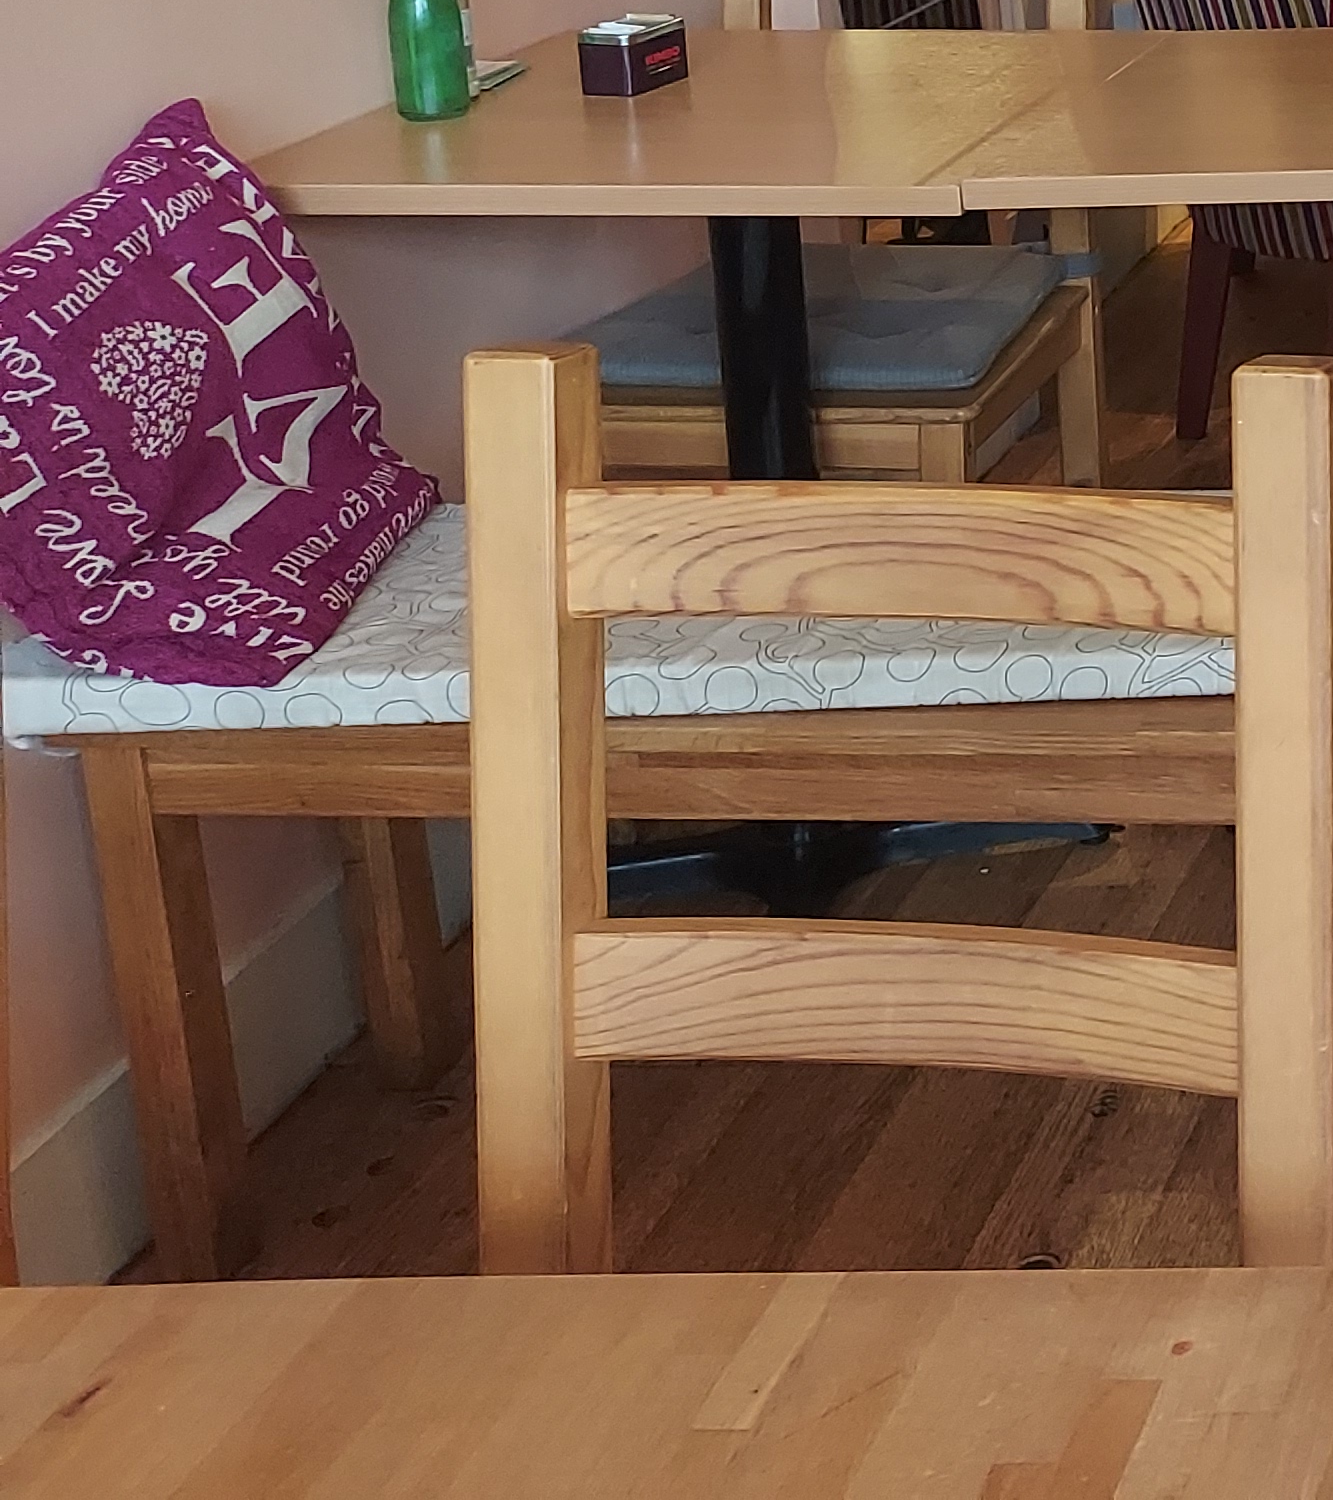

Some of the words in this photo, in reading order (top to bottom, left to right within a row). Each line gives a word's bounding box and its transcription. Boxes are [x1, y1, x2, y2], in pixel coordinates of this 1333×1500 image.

[53, 187, 126, 238] your
[25, 309, 58, 339] I
[51, 256, 123, 324] make
[113, 222, 152, 263] my
[58, 447, 157, 545] need
[338, 489, 370, 531] go
